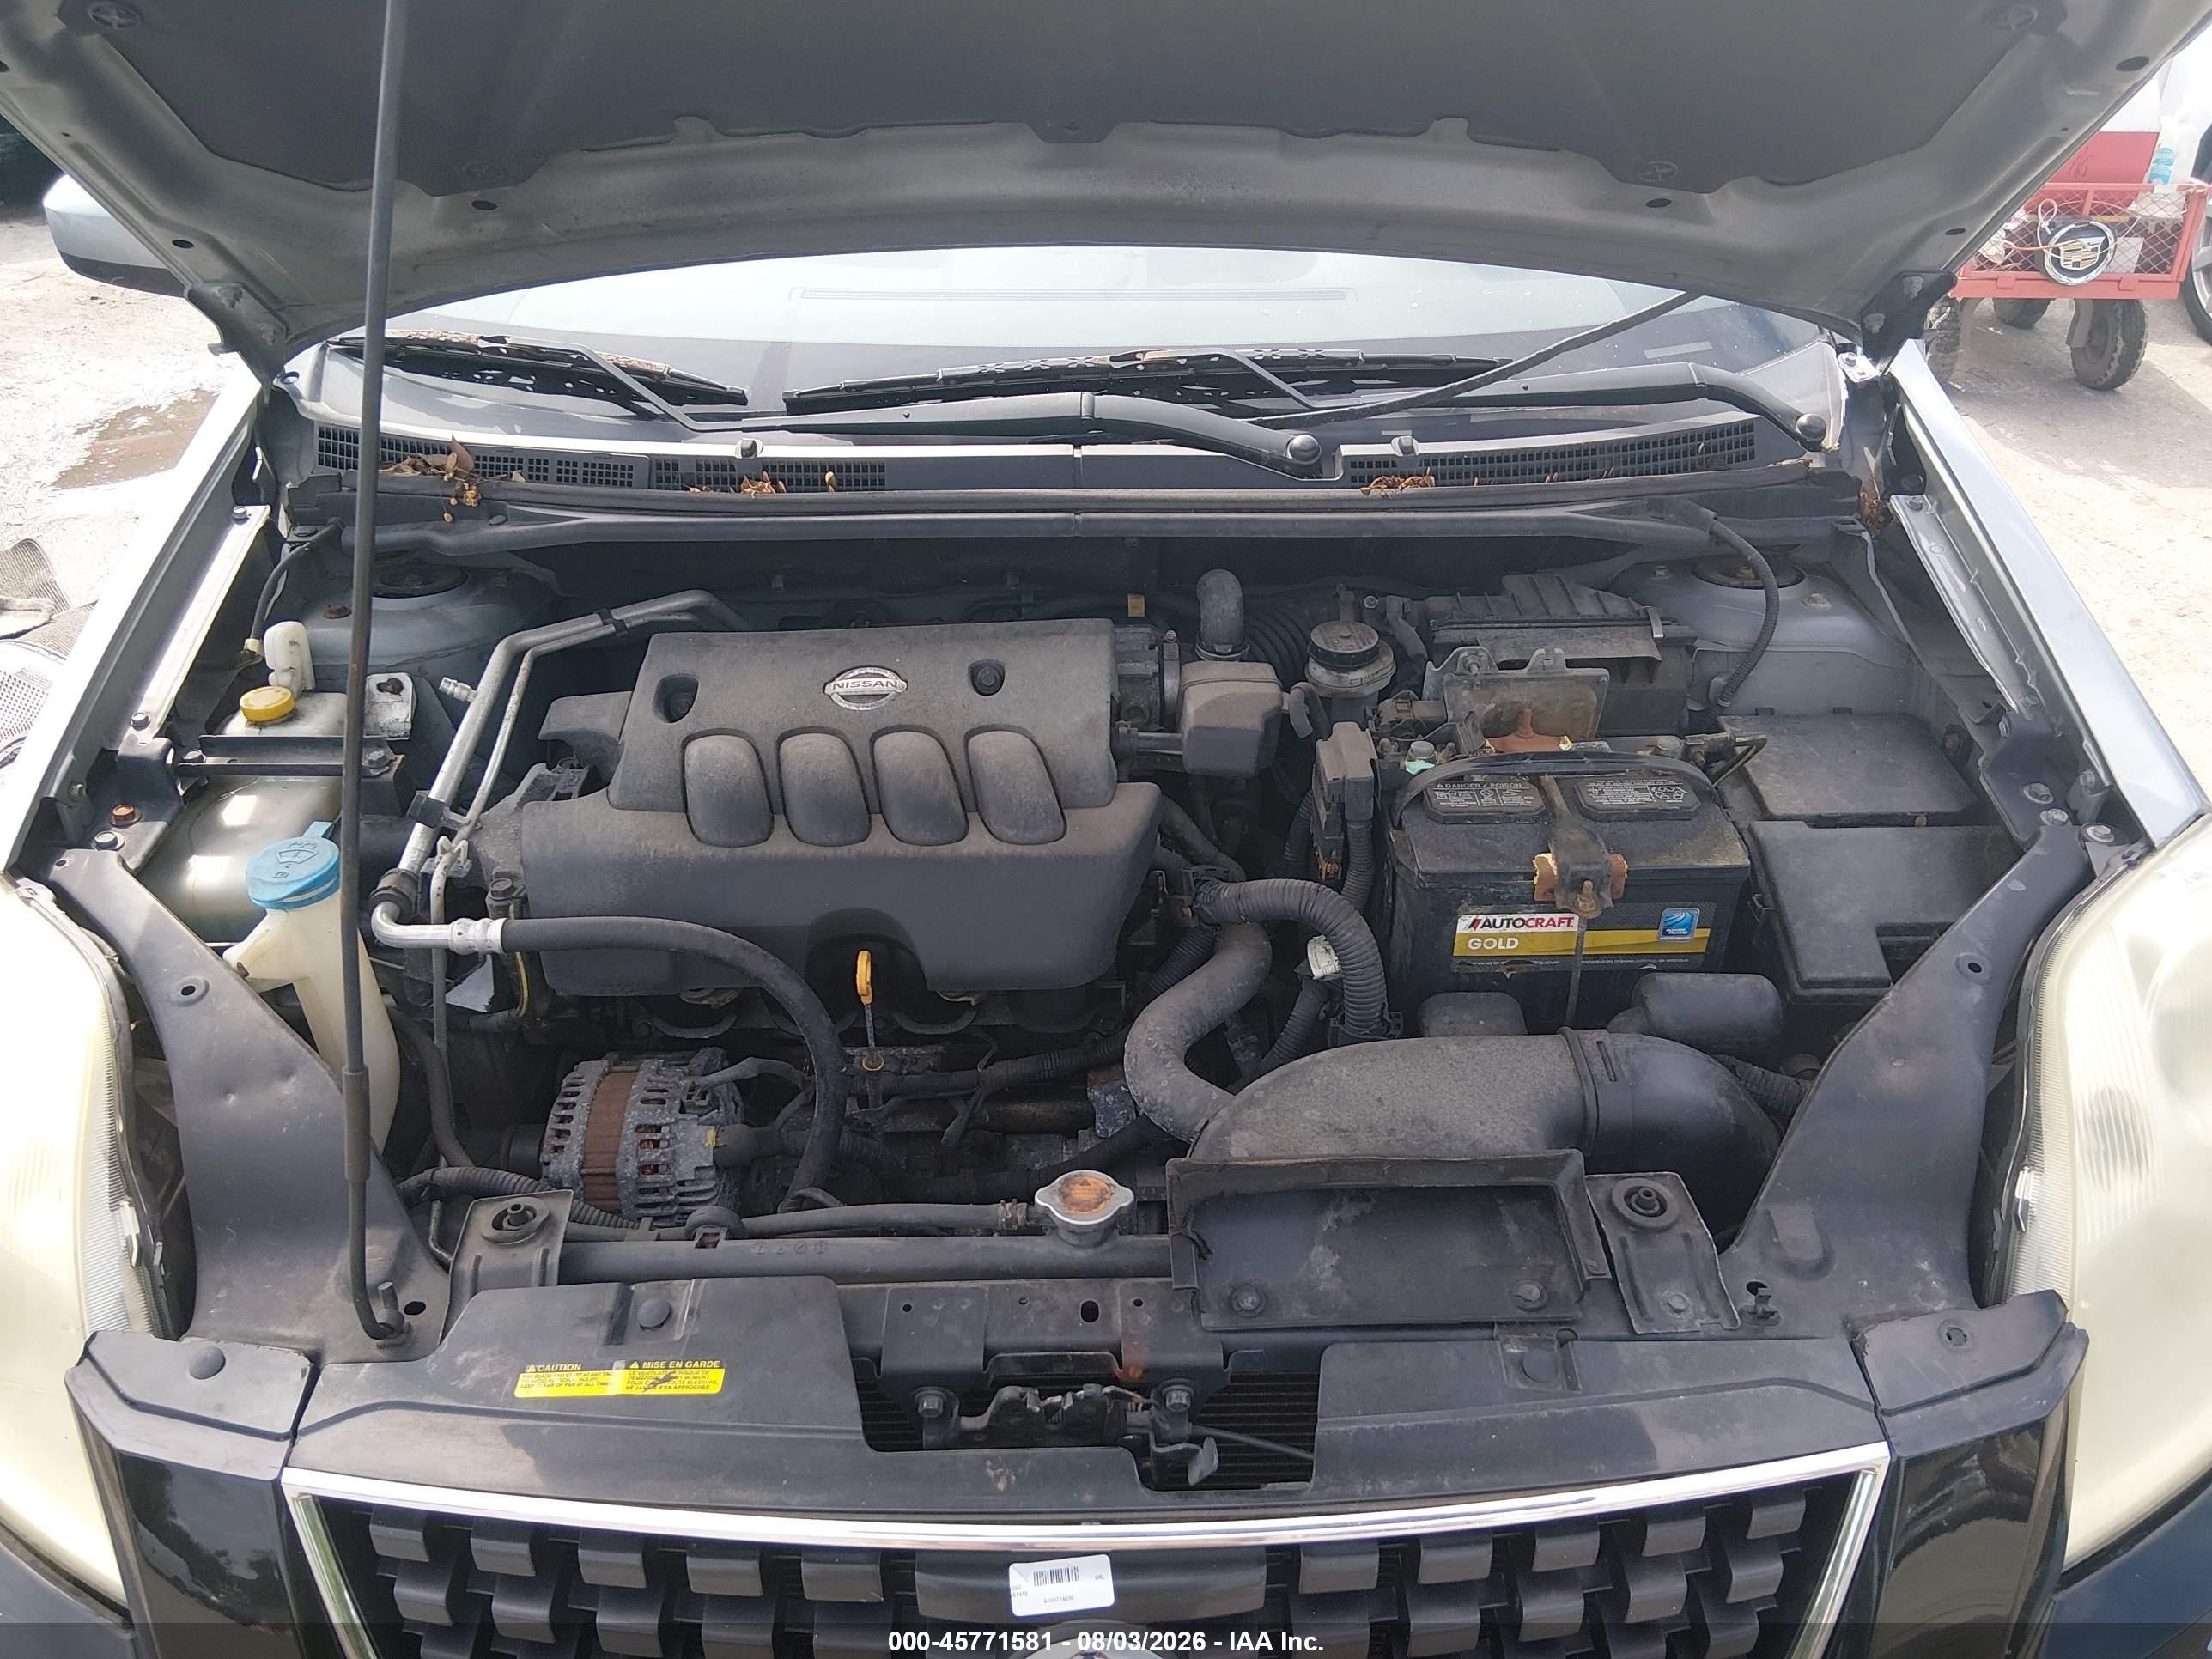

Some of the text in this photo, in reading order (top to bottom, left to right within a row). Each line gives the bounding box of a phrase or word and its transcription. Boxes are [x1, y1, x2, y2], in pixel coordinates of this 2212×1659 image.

[832, 680, 899, 690] NISSAN
[1480, 916, 1574, 929] AUTOCRAFT
[1468, 937, 1519, 950] GOLD
[536, 1364, 582, 1372] CAUTION
